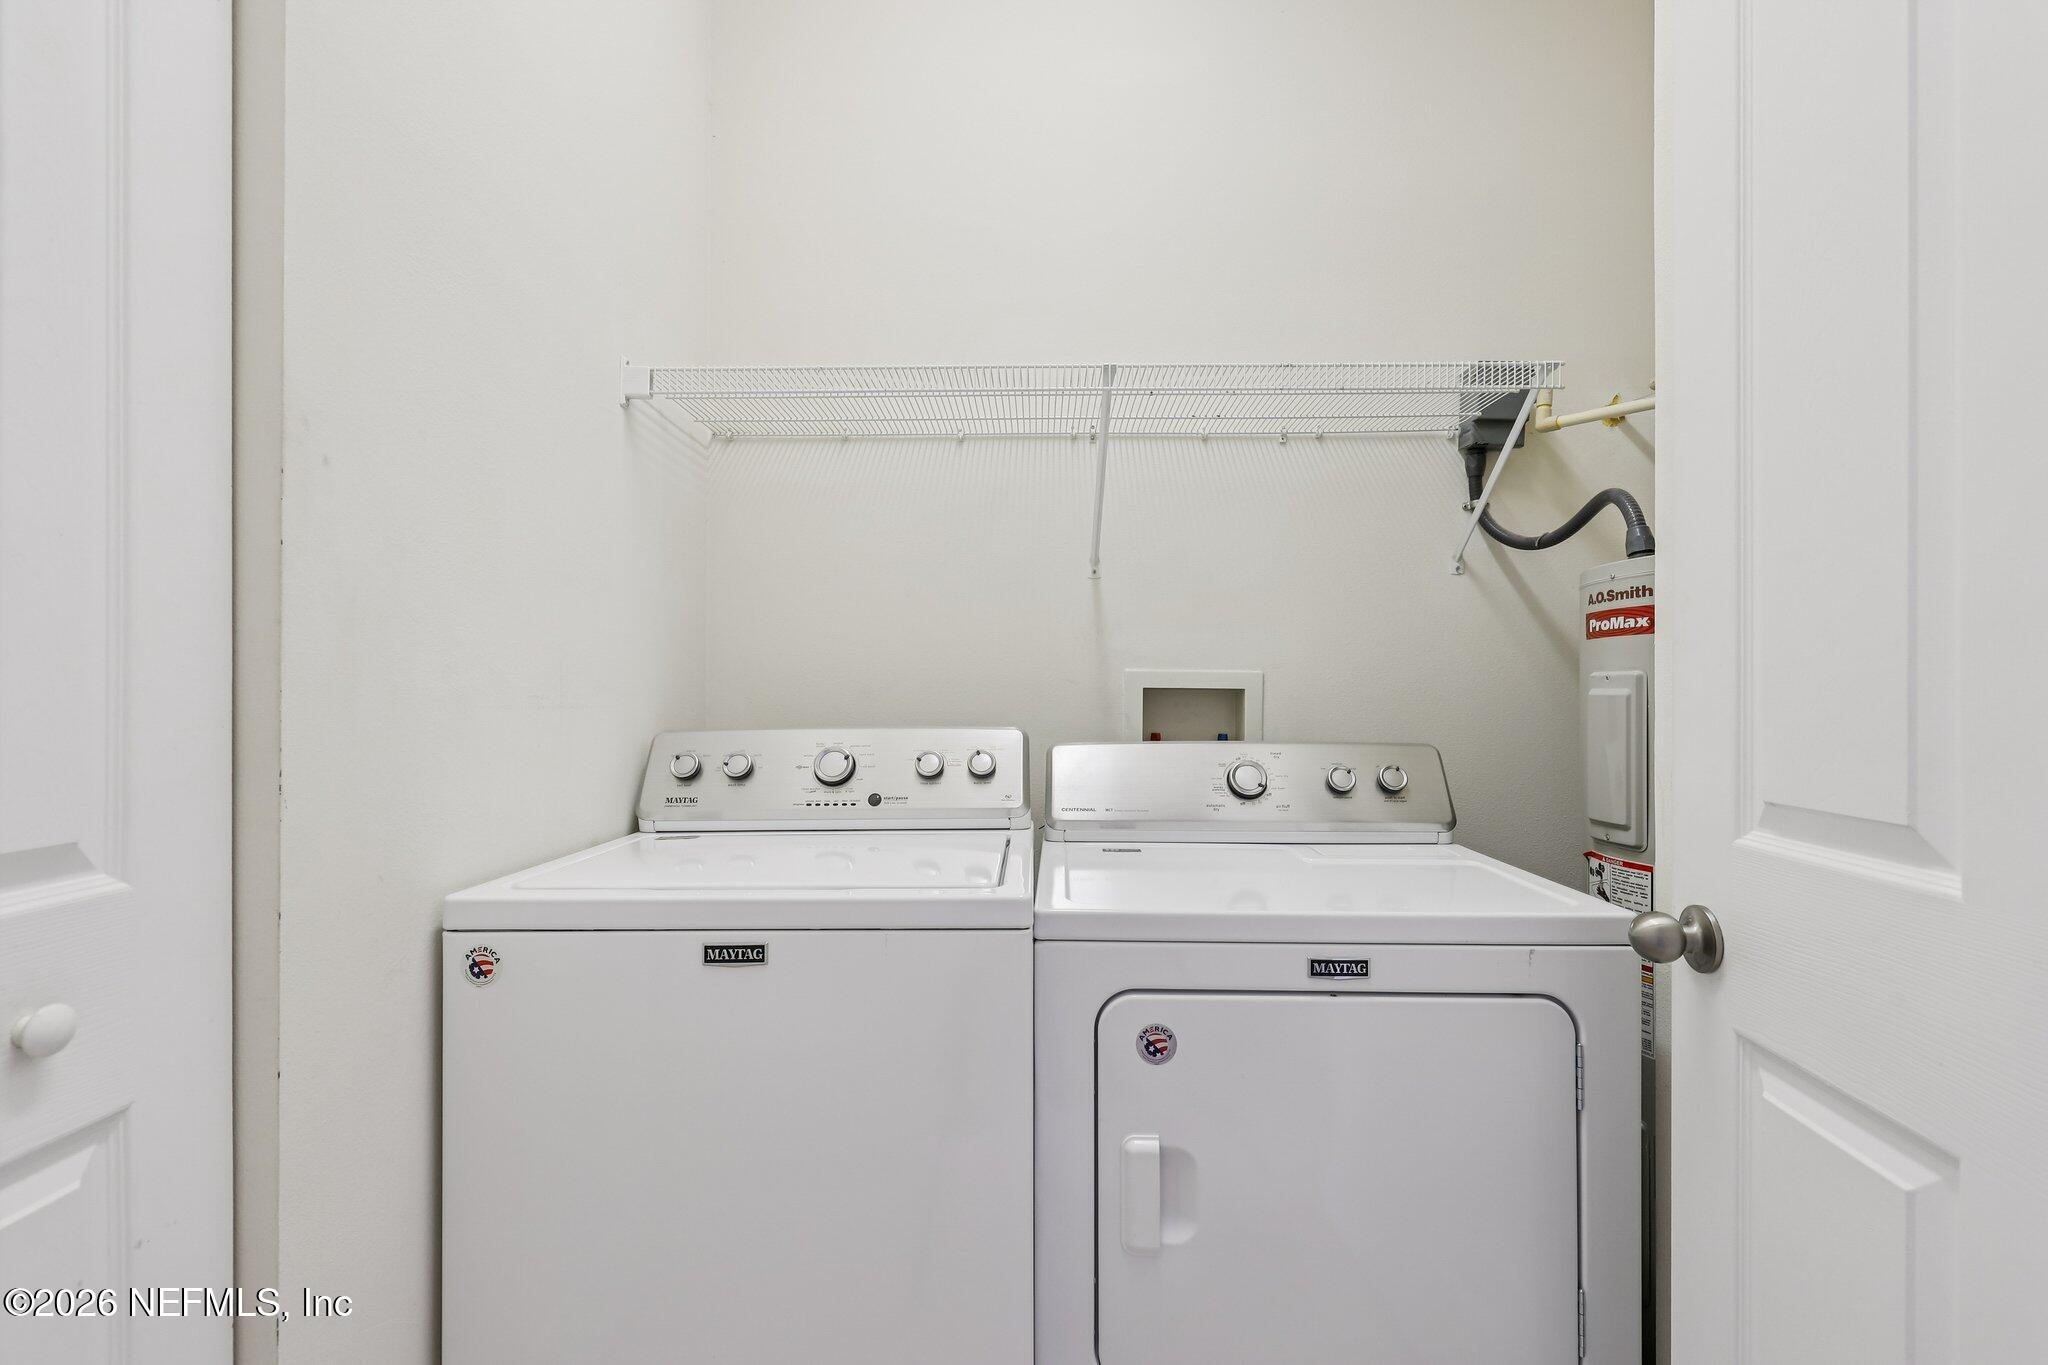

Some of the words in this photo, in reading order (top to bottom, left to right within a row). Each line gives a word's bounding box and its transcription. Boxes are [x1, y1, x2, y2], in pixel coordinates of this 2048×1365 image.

[1589, 616, 1650, 632] ProMax
[465, 946, 501, 964] AMERICA
[707, 948, 763, 960] MAYTAG
[1312, 962, 1367, 974] MAYTAG
[1139, 1026, 1173, 1041] AMERICA
